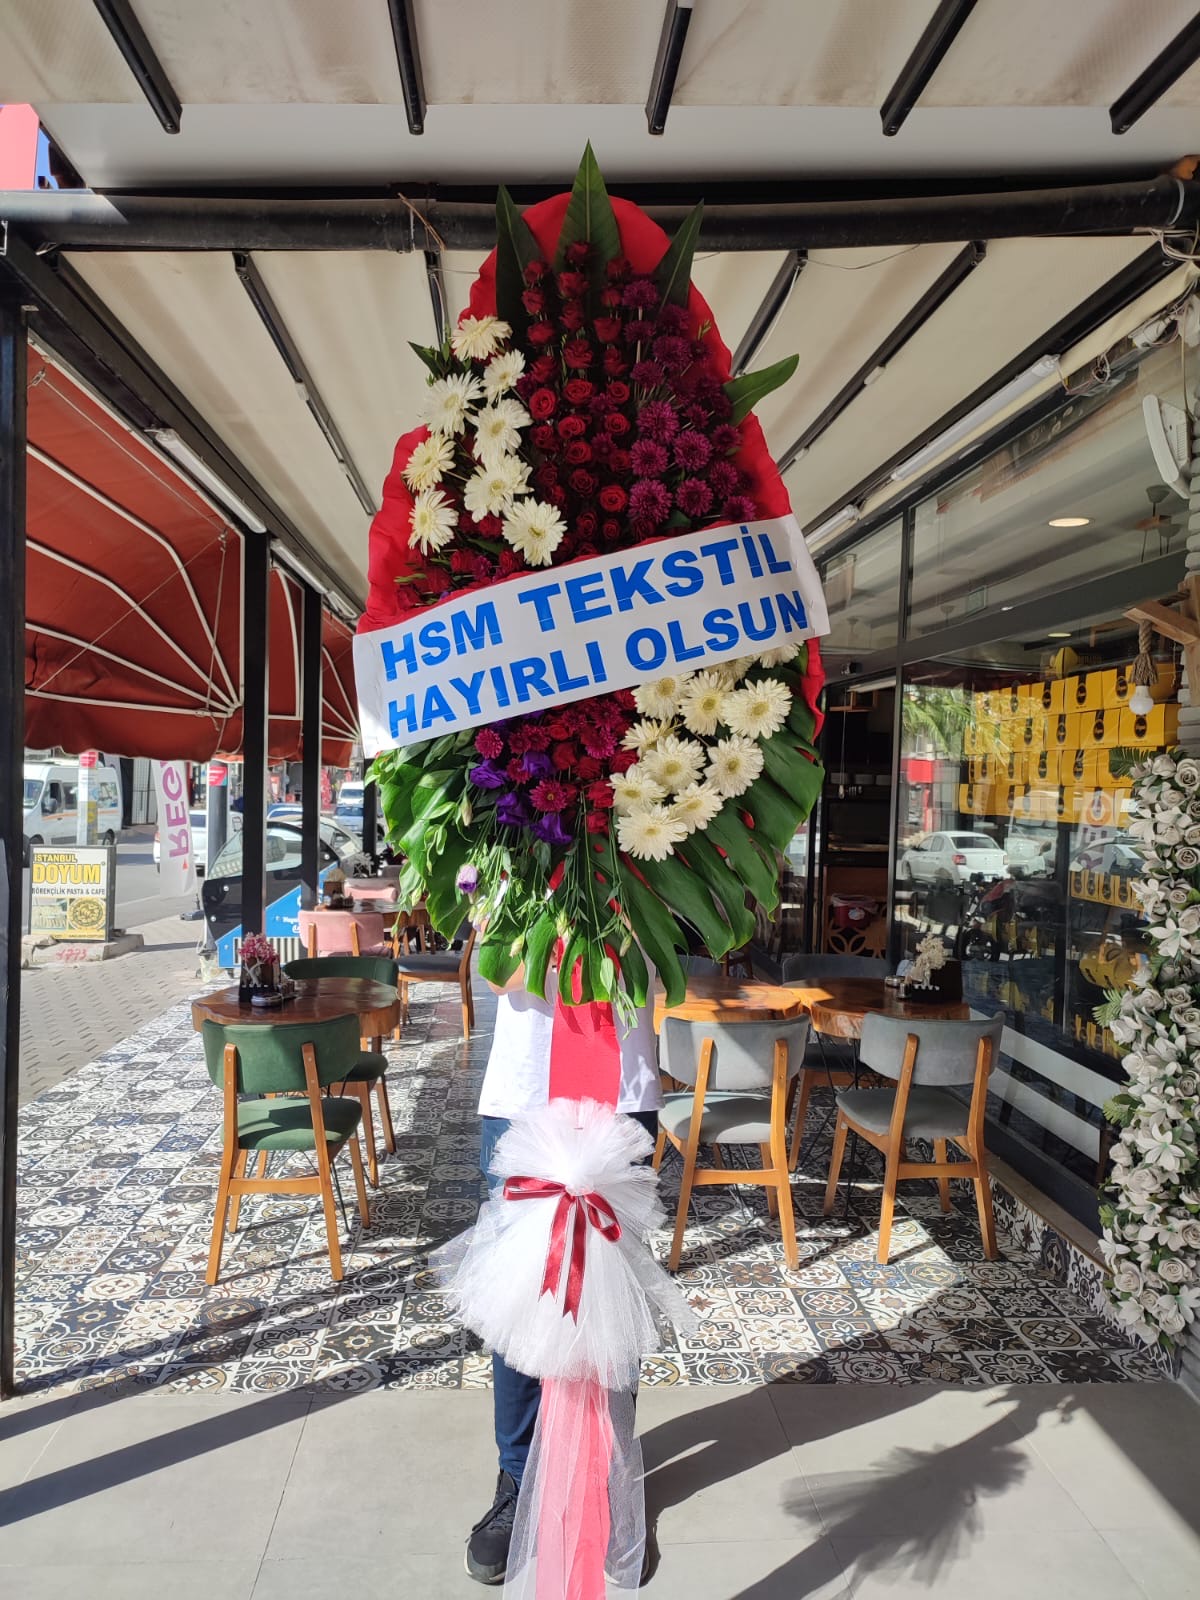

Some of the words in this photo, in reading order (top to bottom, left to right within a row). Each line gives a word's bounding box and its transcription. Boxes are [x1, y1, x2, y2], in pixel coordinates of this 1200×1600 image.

[381, 601, 503, 682] HSM
[518, 525, 793, 632] TEKSTİL
[387, 641, 607, 739] HAYIRLI
[625, 590, 808, 672] OLSUN
[32, 864, 101, 884] DOYUM
